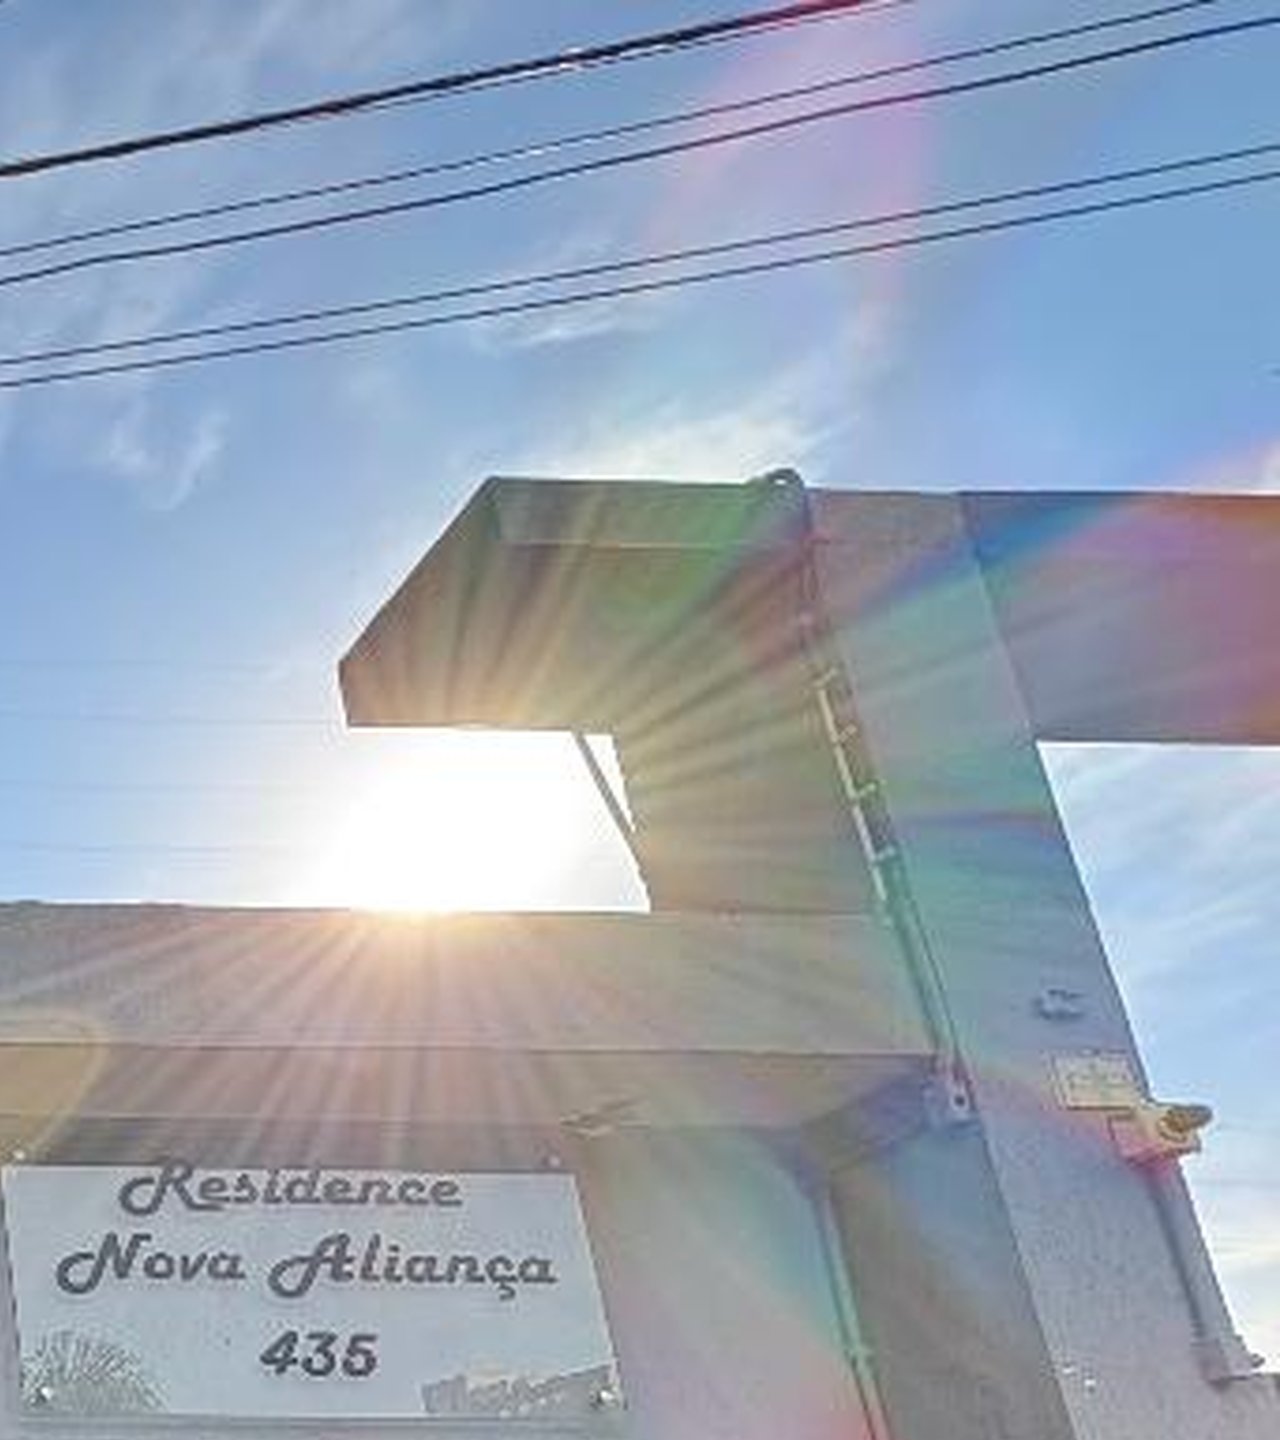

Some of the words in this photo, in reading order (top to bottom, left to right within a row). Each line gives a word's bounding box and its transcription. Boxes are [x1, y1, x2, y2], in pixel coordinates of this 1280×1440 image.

[118, 1158, 463, 1216] Residence
[57, 1231, 246, 1294] Nova
[266, 1232, 558, 1301] Aliança
[259, 1329, 378, 1377] 435
